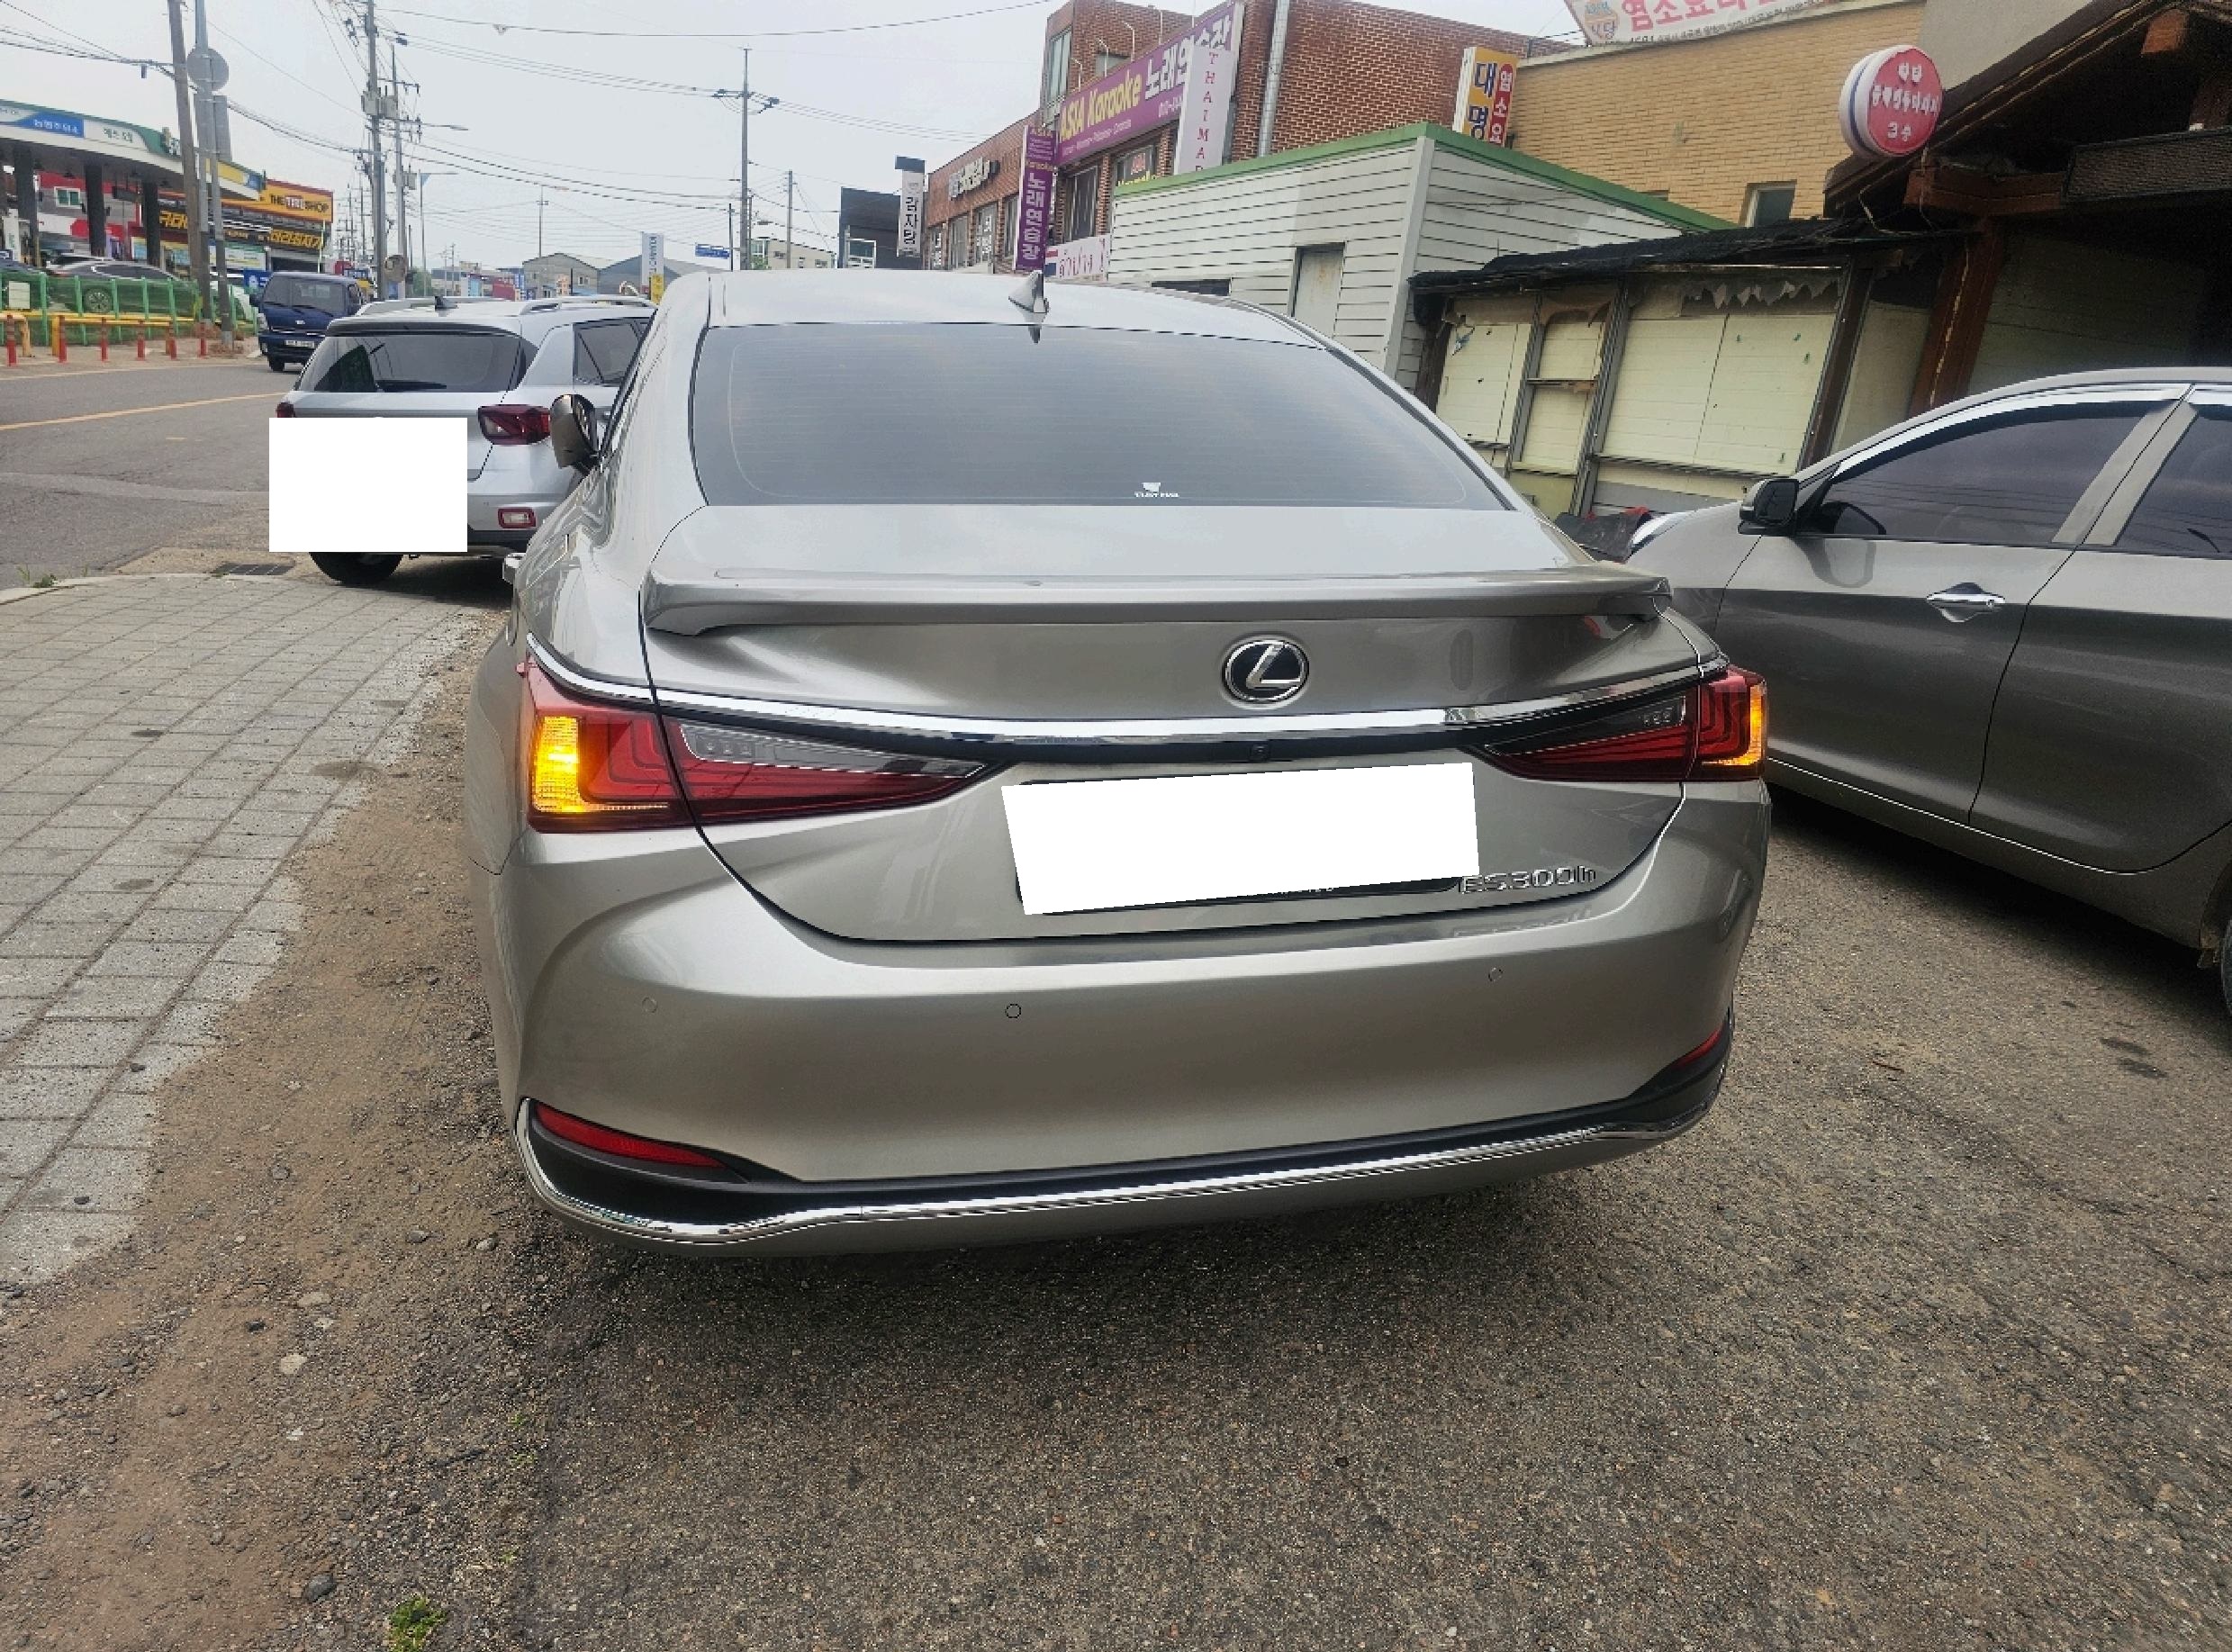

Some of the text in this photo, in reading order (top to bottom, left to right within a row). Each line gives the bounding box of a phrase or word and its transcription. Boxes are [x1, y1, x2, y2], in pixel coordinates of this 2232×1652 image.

[1059, 96, 1084, 143] ASIA
[1088, 69, 1143, 127] Karaoke
[1469, 62, 1498, 140] 대명
[270, 194, 285, 206] THE
[304, 202, 330, 213] SHOP
[1022, 172, 1046, 260] 노래연습장
[1460, 865, 1596, 894] ES300h
